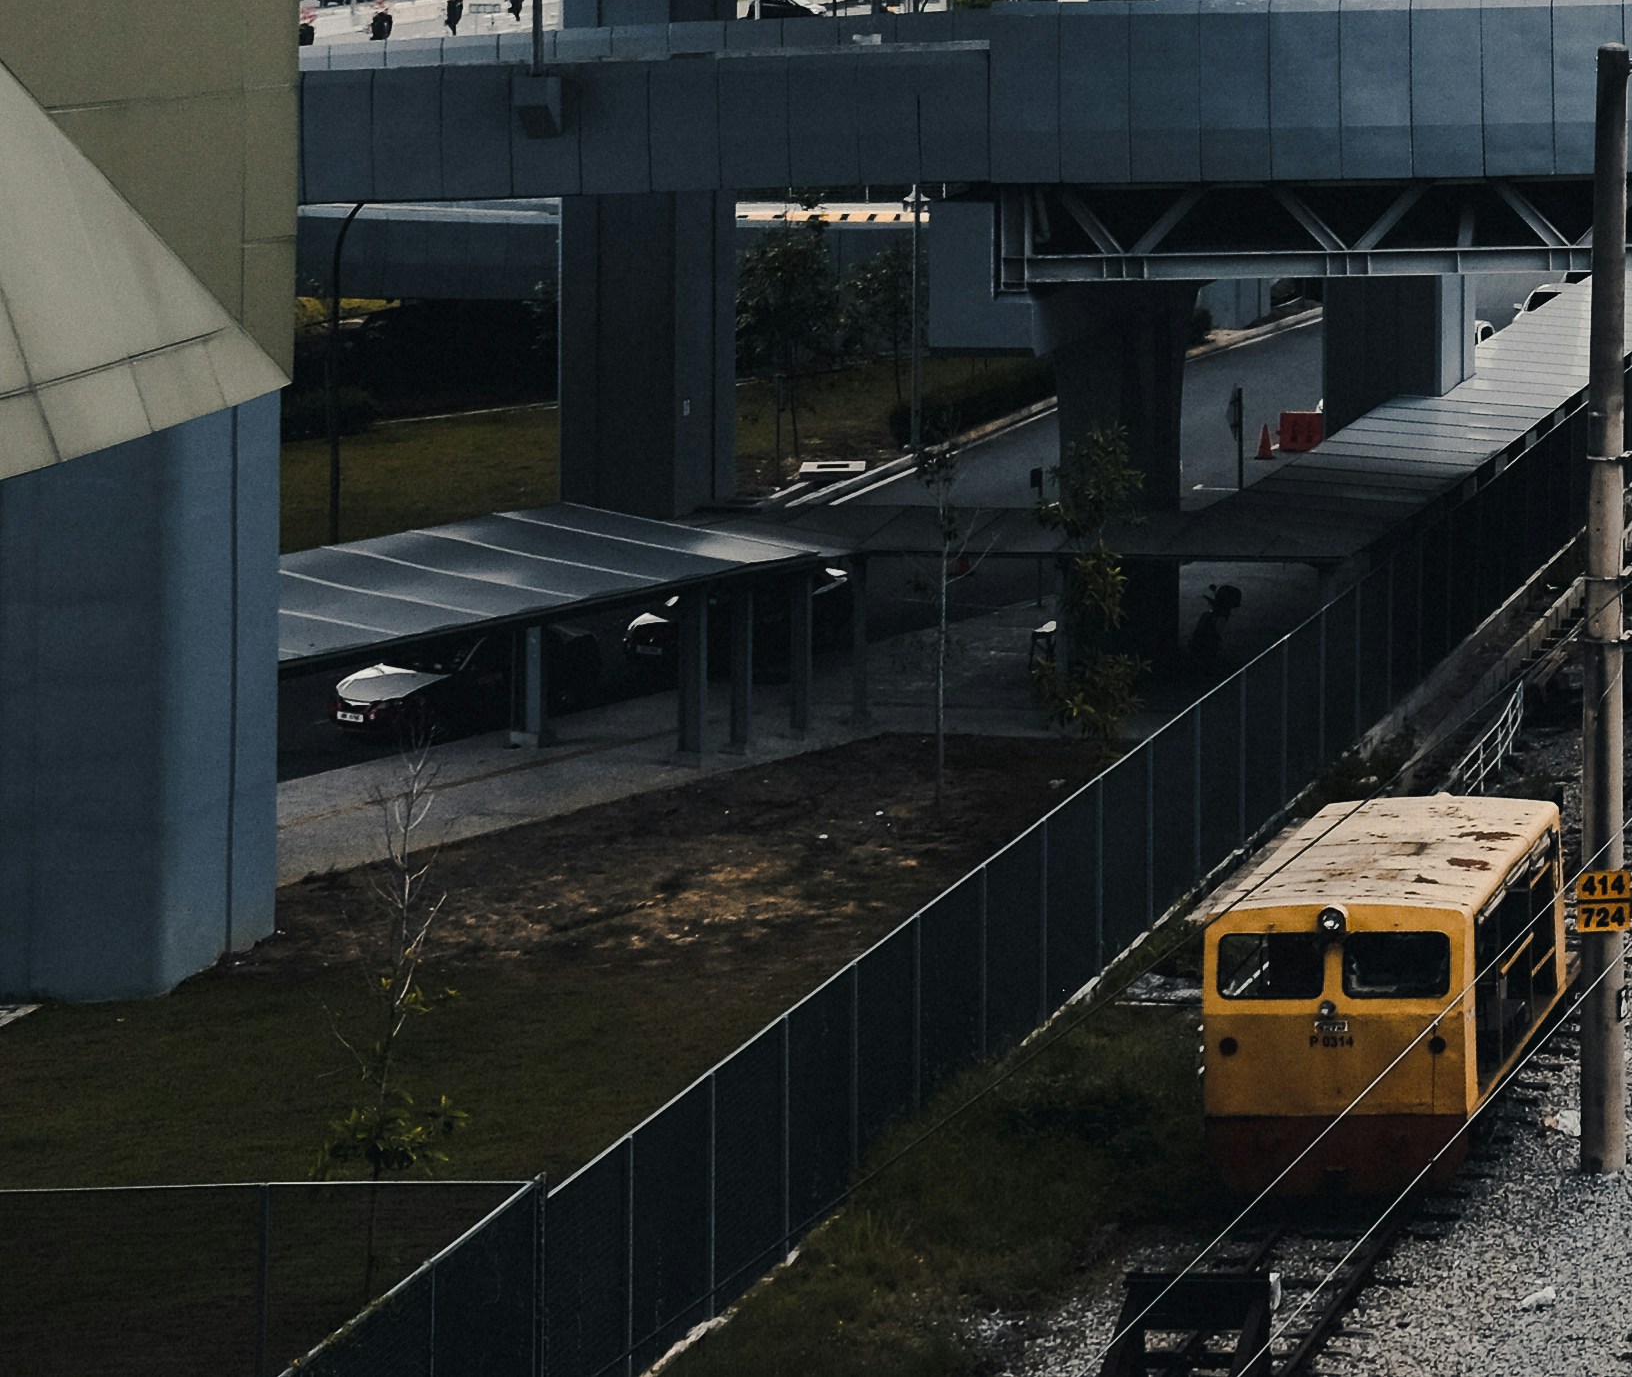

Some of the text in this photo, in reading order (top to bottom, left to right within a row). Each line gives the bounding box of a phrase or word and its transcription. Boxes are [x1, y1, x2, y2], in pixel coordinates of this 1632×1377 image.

[1581, 874, 1626, 896] 414
[1581, 905, 1626, 929] 724
[1309, 1034, 1319, 1048] P
